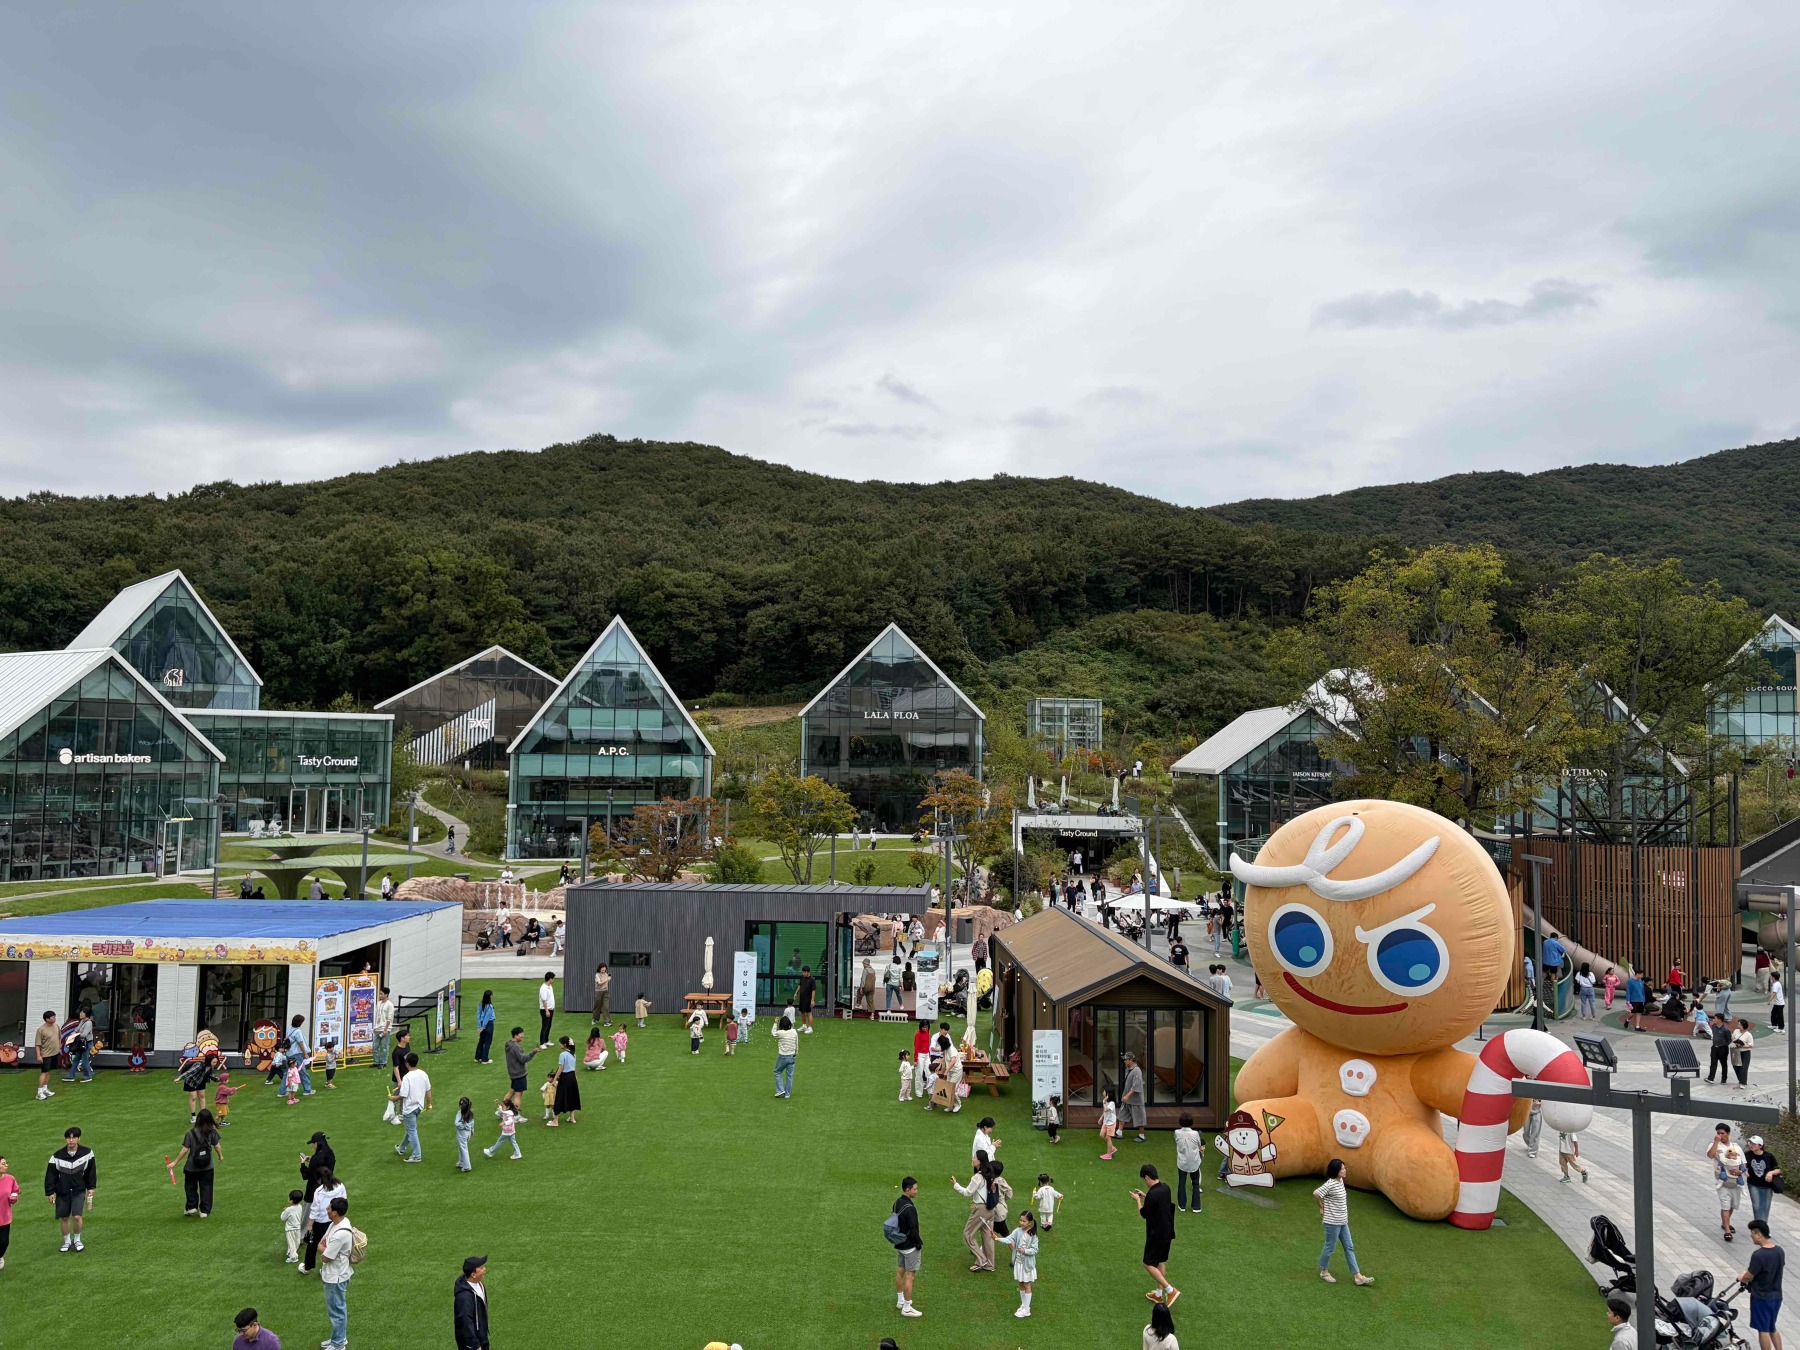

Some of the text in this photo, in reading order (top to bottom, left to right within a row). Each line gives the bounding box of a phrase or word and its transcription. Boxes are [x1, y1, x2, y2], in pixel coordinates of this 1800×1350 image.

[864, 711, 919, 720] LALA FLOA
[467, 718, 491, 730] PXG
[598, 746, 629, 756] A.P.C.
[74, 753, 151, 764] artisan bakers
[297, 755, 358, 768] Tasty Ground
[1059, 829, 1098, 838] Tasty Ground
